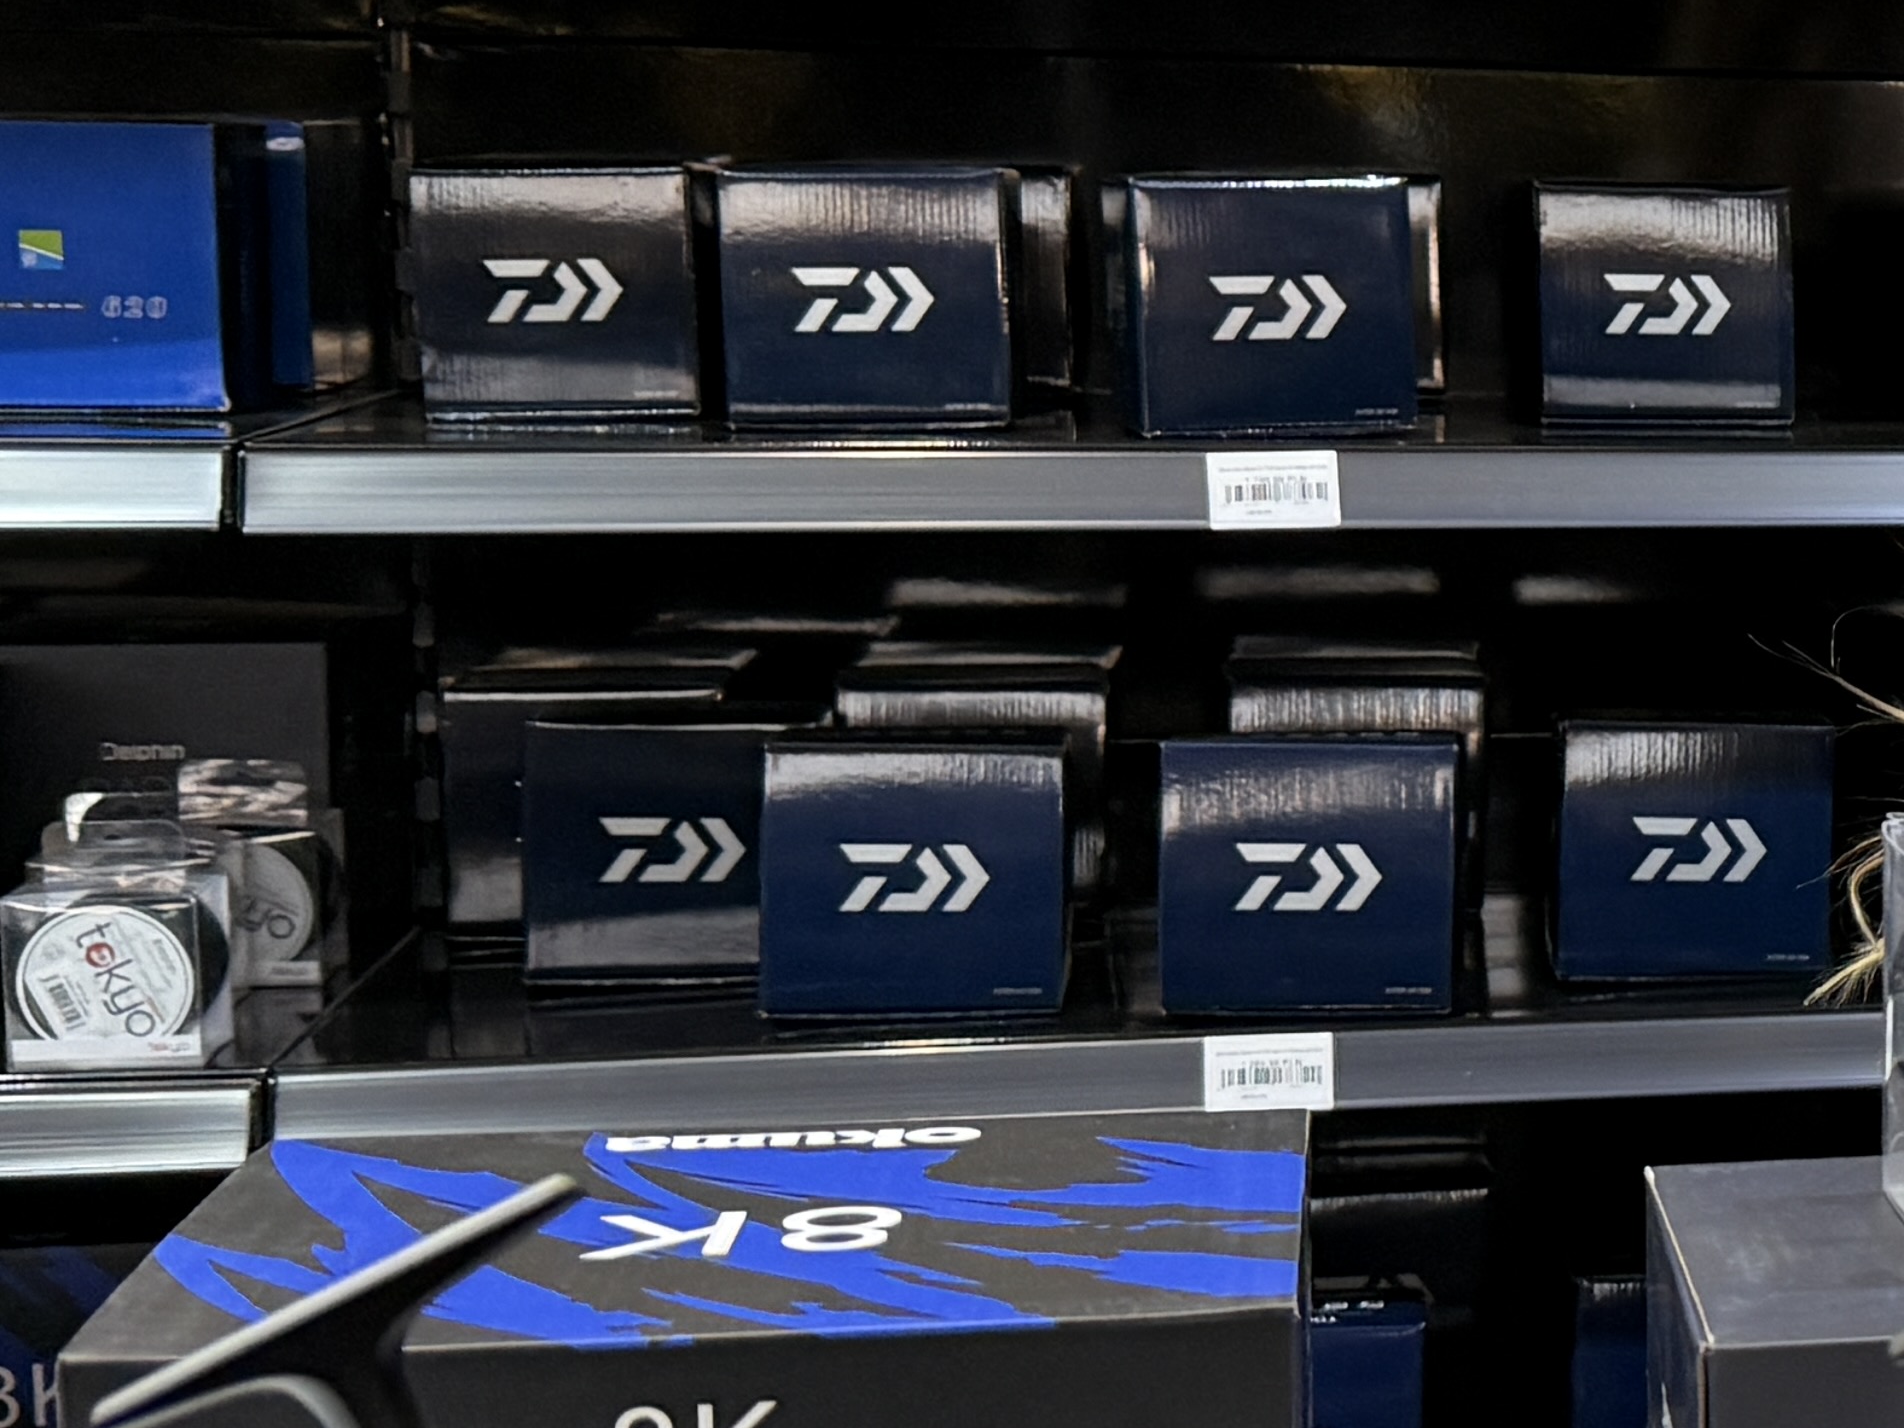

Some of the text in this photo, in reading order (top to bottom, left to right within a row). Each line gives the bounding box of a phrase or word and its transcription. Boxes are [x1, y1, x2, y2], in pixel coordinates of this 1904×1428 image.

[75, 920, 157, 1038] tokyo
[605, 1126, 983, 1153] okuma
[579, 1205, 903, 1262] 8K
